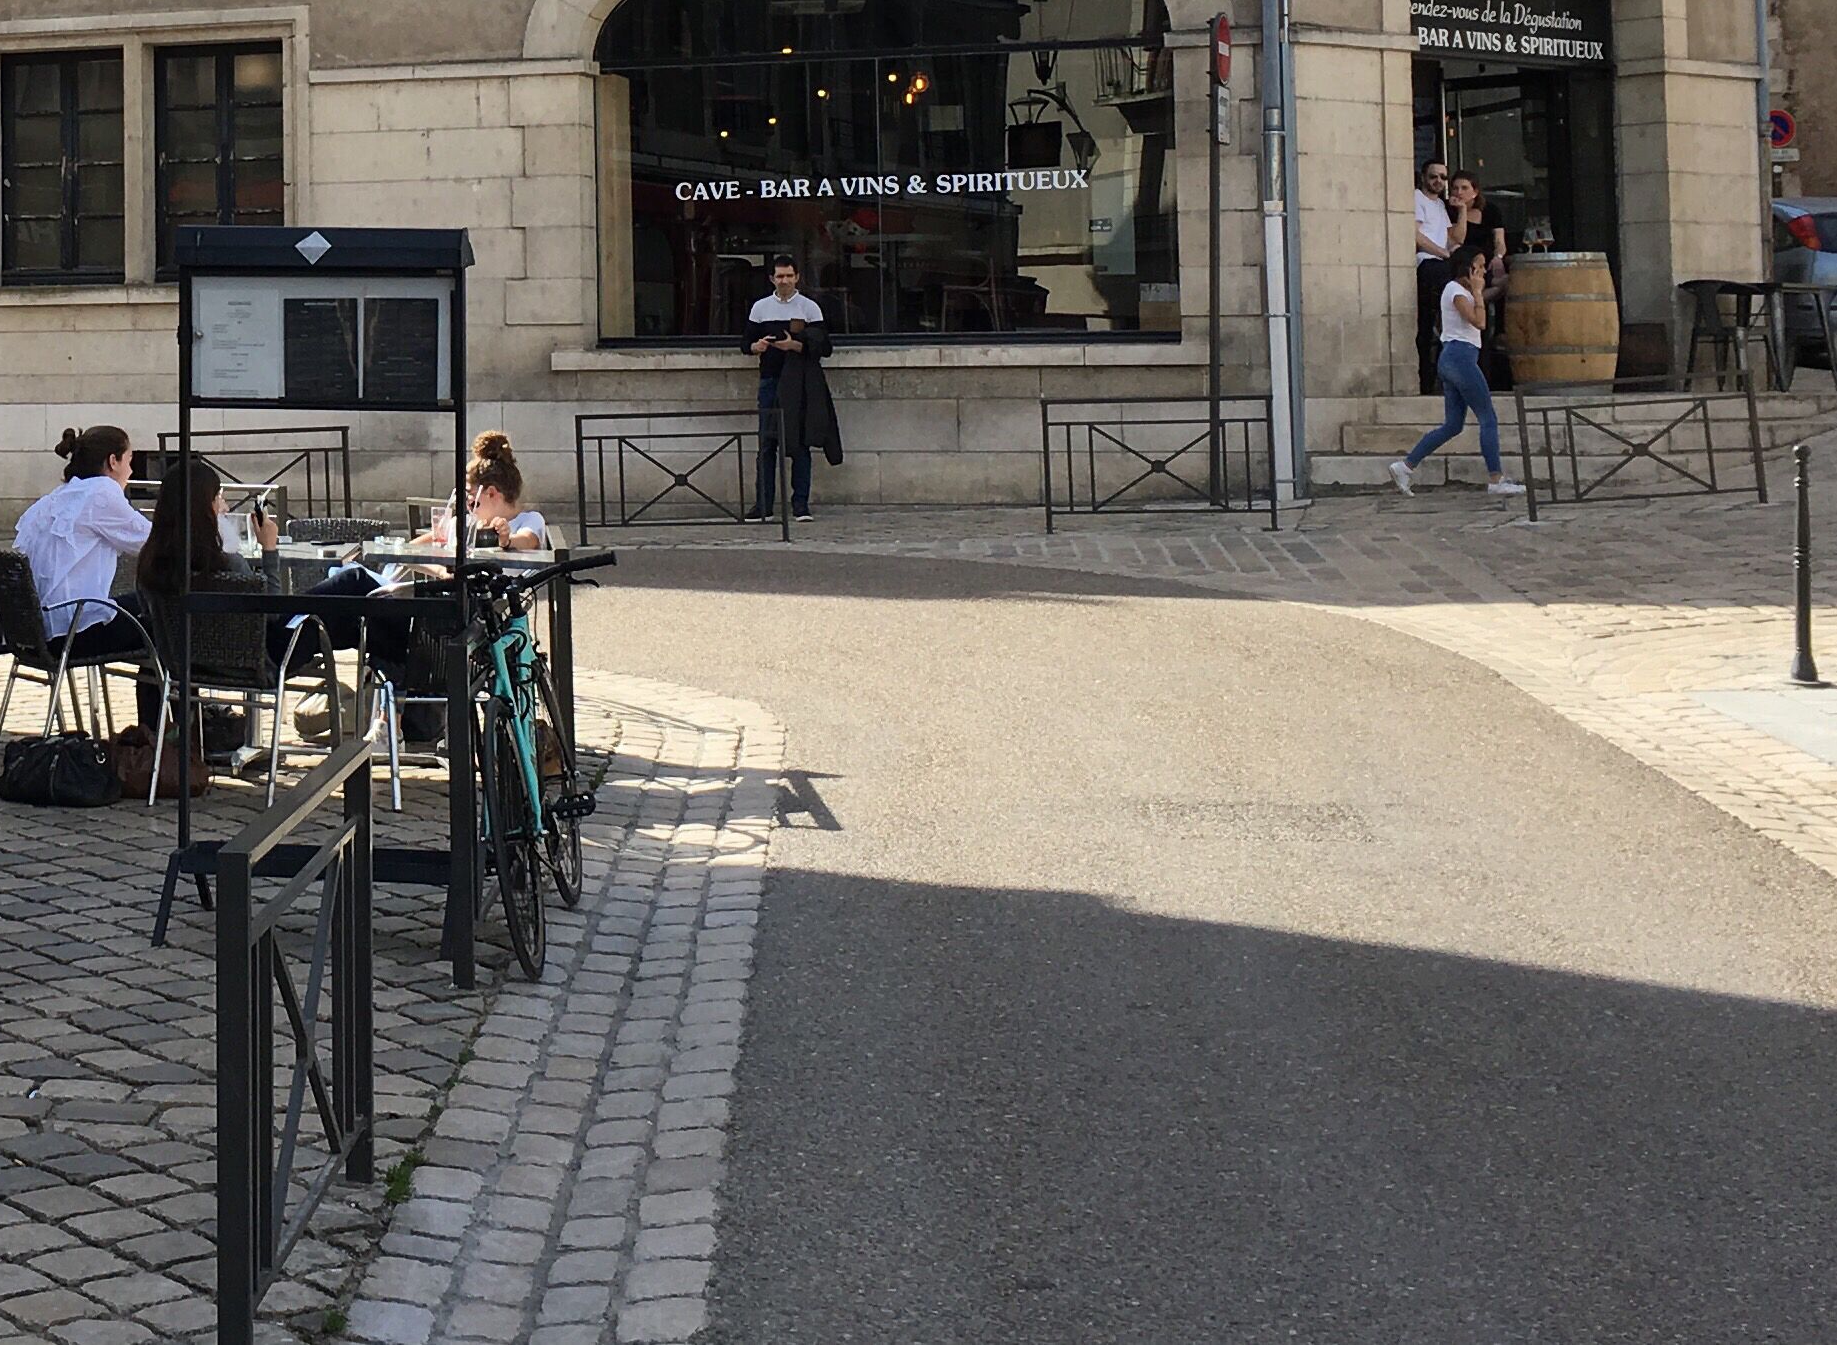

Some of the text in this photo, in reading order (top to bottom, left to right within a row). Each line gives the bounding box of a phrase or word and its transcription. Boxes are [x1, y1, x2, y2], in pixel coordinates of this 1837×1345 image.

[1481, 0, 1497, 23] de
[1499, 1, 1511, 24] la
[1513, 3, 1582, 34] Dégustation
[1417, 27, 1605, 60] BAR A VINS & SPIRITUEUX
[675, 181, 741, 201] CAVE
[761, 178, 811, 199] BAR
[816, 179, 835, 198] A
[840, 175, 901, 197] VINS
[906, 174, 928, 195] &
[935, 169, 1089, 195] SPIRITUEUX
